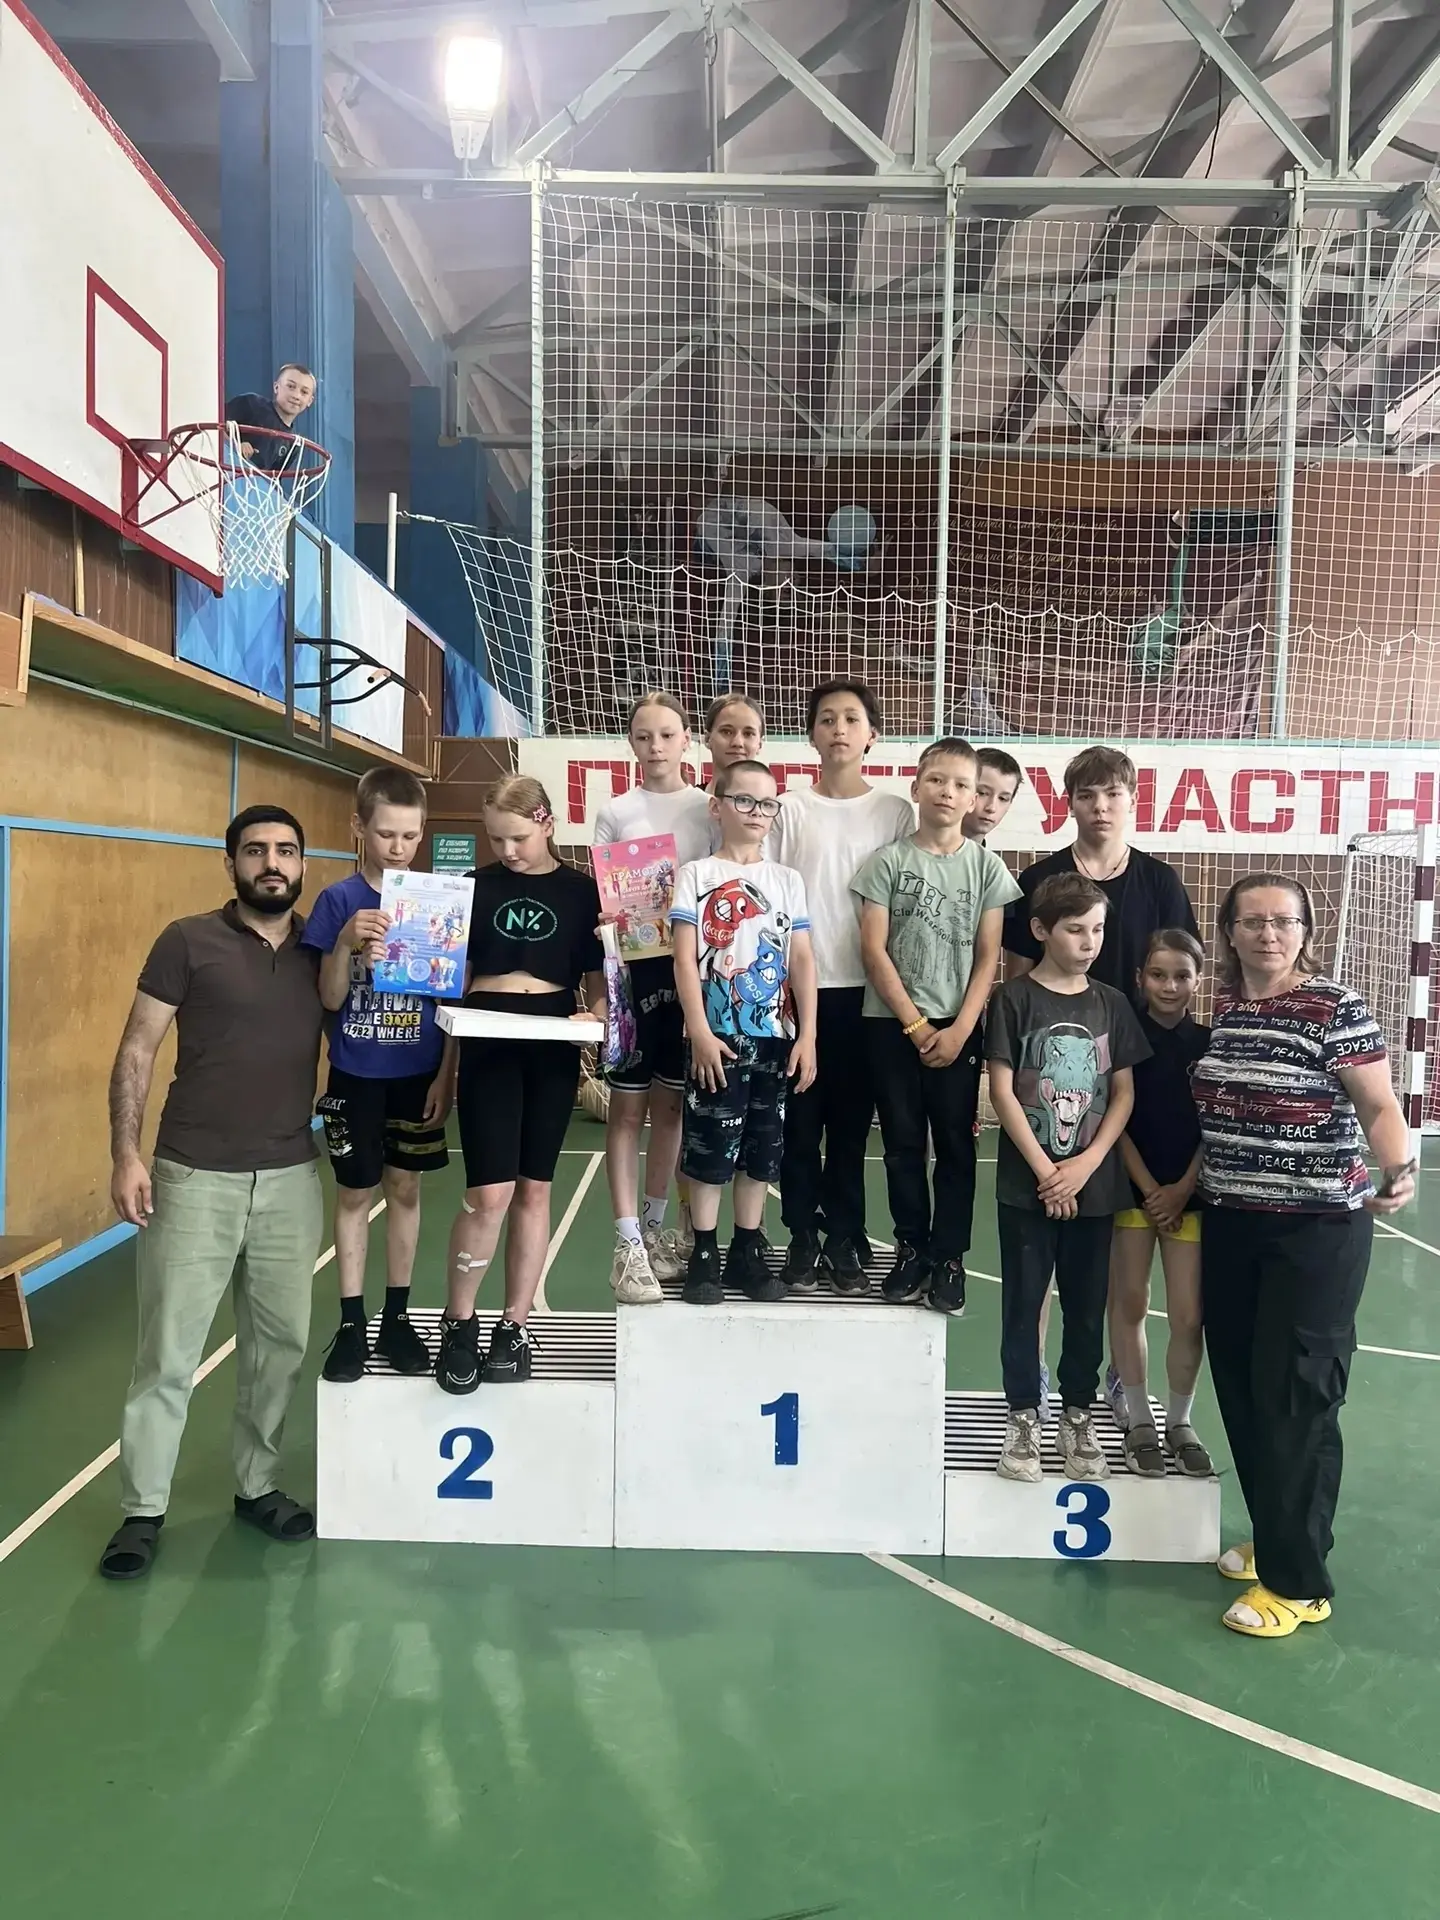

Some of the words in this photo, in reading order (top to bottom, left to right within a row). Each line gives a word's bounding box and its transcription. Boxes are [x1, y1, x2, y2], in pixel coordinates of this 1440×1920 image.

[916, 907, 938, 929] Wear
[384, 1013, 418, 1024] STYLE
[345, 1026, 370, 1037] 1982
[377, 1026, 420, 1039] WHERE
[1336, 1038, 1374, 1057] PEACE
[1299, 1075, 1328, 1087] heart
[1212, 1103, 1235, 1121] love
[1279, 1124, 1317, 1139] PEACE
[1258, 1154, 1297, 1171] PEACE
[1305, 1156, 1335, 1165] LOVE
[1291, 1186, 1322, 1198] heart
[761, 1392, 799, 1465] 1
[437, 1427, 494, 1499] 2
[1053, 1482, 1112, 1558] 3
